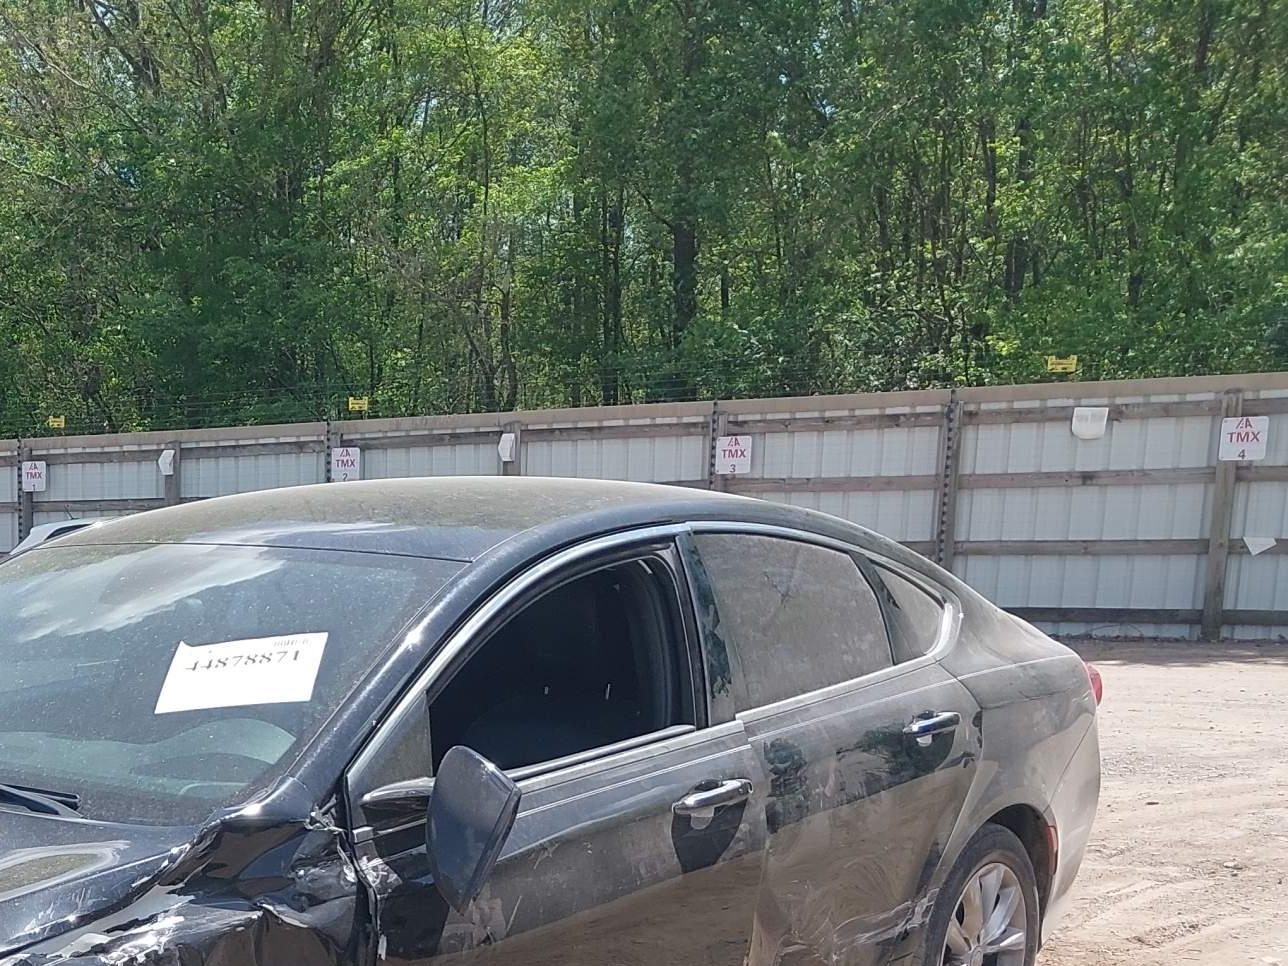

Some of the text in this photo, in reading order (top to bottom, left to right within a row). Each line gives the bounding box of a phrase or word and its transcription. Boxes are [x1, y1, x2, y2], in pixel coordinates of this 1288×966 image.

[1226, 431, 1261, 443] TMX
[722, 449, 746, 459] TMX
[1237, 449, 1246, 460] 4
[335, 459, 356, 468] TMX
[729, 464, 737, 473] 3
[26, 471, 43, 480] TMX
[342, 472, 349, 481] 2
[184, 649, 300, 672] 44878871
